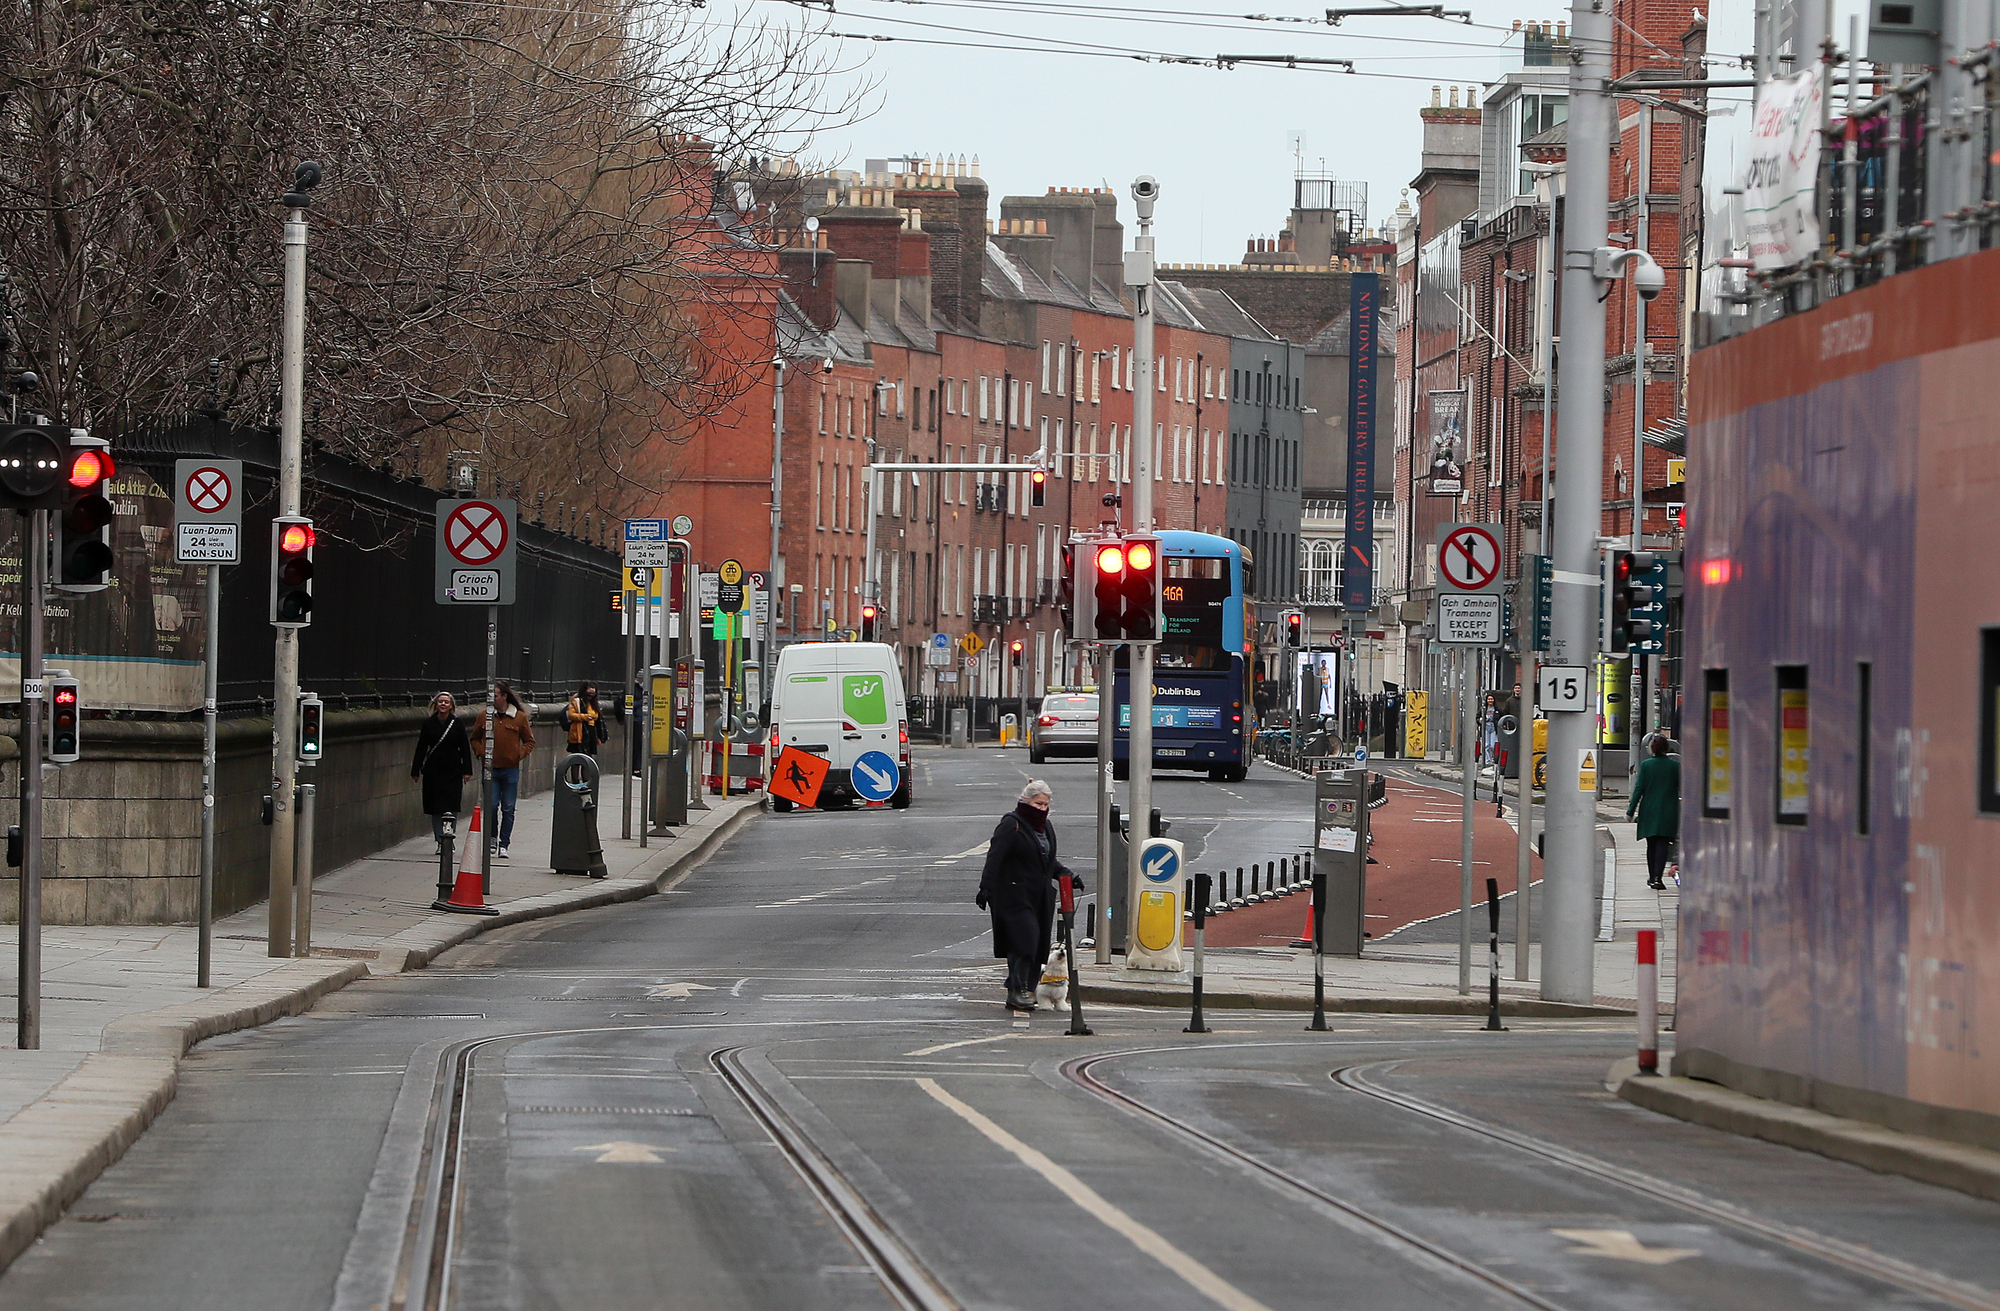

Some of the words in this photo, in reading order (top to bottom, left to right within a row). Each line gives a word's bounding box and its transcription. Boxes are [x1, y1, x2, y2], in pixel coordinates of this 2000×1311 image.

[1358, 291, 1371, 373] NATIONAL
[1356, 378, 1369, 450] GALLERY
[1434, 406, 1460, 414] BREAK
[109, 478, 126, 495] aile
[126, 476, 147, 496] Átha
[1354, 461, 1368, 532] IRELAND
[190, 537, 206, 547] 24
[182, 549, 233, 558] MON-SUN
[463, 586, 489, 596] END
[1162, 586, 1184, 601] 46A
[1441, 598, 1459, 607] Ach
[1446, 609, 1493, 617] Tramanna
[1449, 620, 1489, 629] EXCEPT
[1451, 630, 1488, 639] TRAMS
[853, 680, 879, 698] eir
[1157, 687, 1184, 696] Dublin
[1184, 687, 1201, 696] Bus
[1548, 677, 1578, 700] 15
